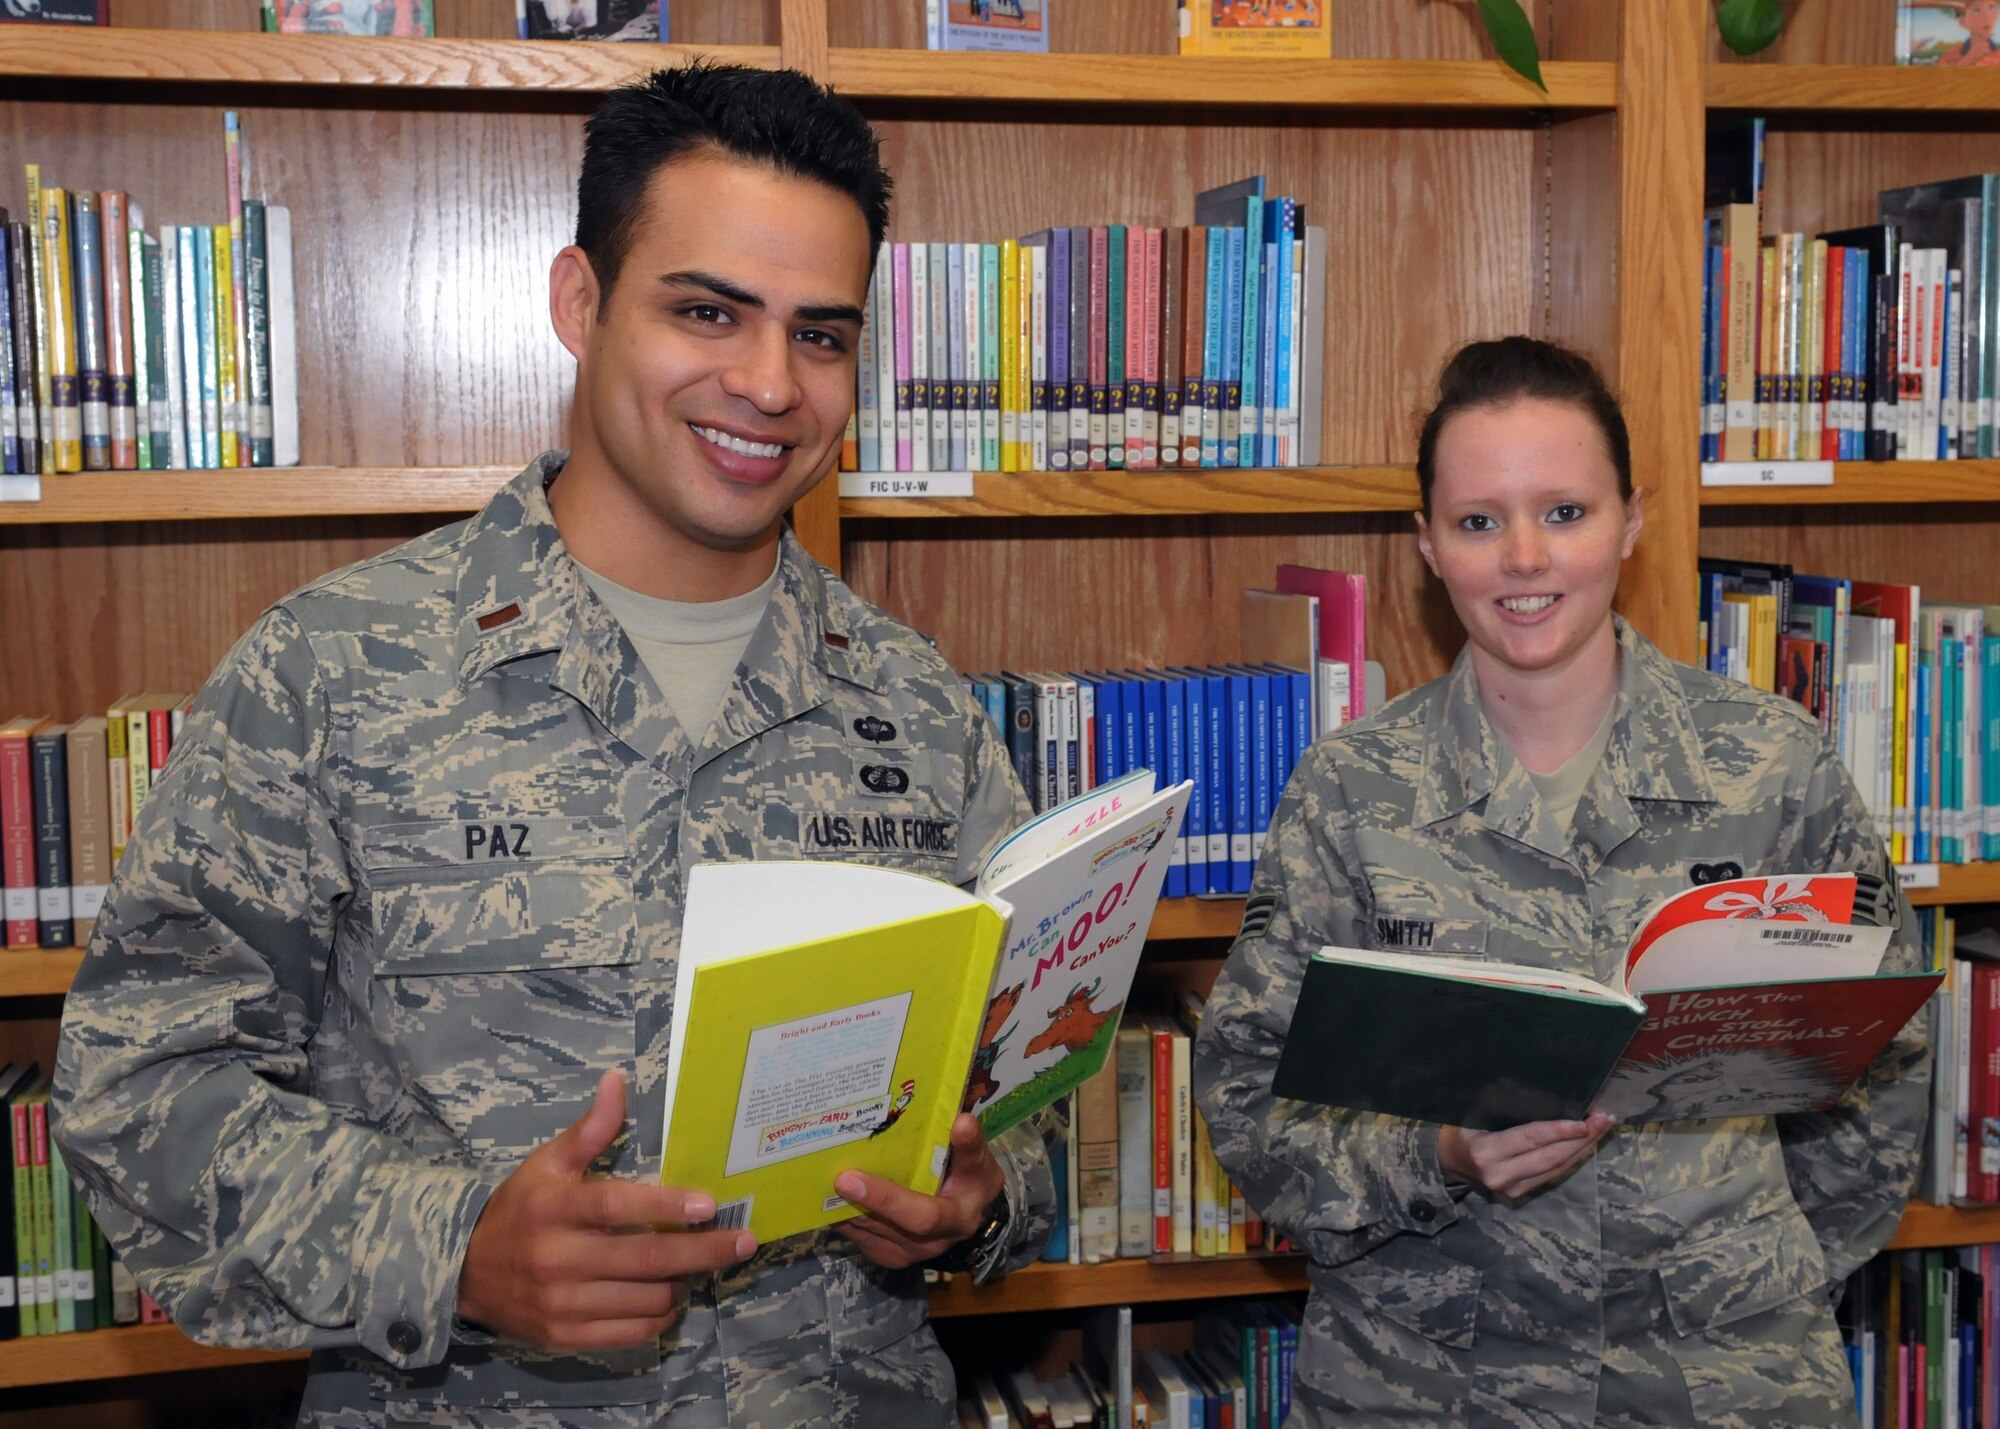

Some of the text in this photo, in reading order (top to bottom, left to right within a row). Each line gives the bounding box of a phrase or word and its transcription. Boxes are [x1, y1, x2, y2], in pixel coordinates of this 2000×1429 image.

[870, 481, 929, 492] FIC U-V-W
[1048, 744, 1056, 769] WHITE
[465, 824, 531, 860] PAZ
[813, 817, 952, 852] U.S. AIR FORCE
[83, 843, 95, 873] THE
[1009, 890, 1094, 961] Mr. Brown
[1030, 859, 1149, 993] MOO!
[1098, 921, 1137, 956] You?
[1378, 918, 1435, 946] SMITH
[781, 1009, 882, 1040] Bright and Early Books
[1643, 1008, 1754, 1031] GRINCH
[1717, 1018, 1805, 1033] STOLE
